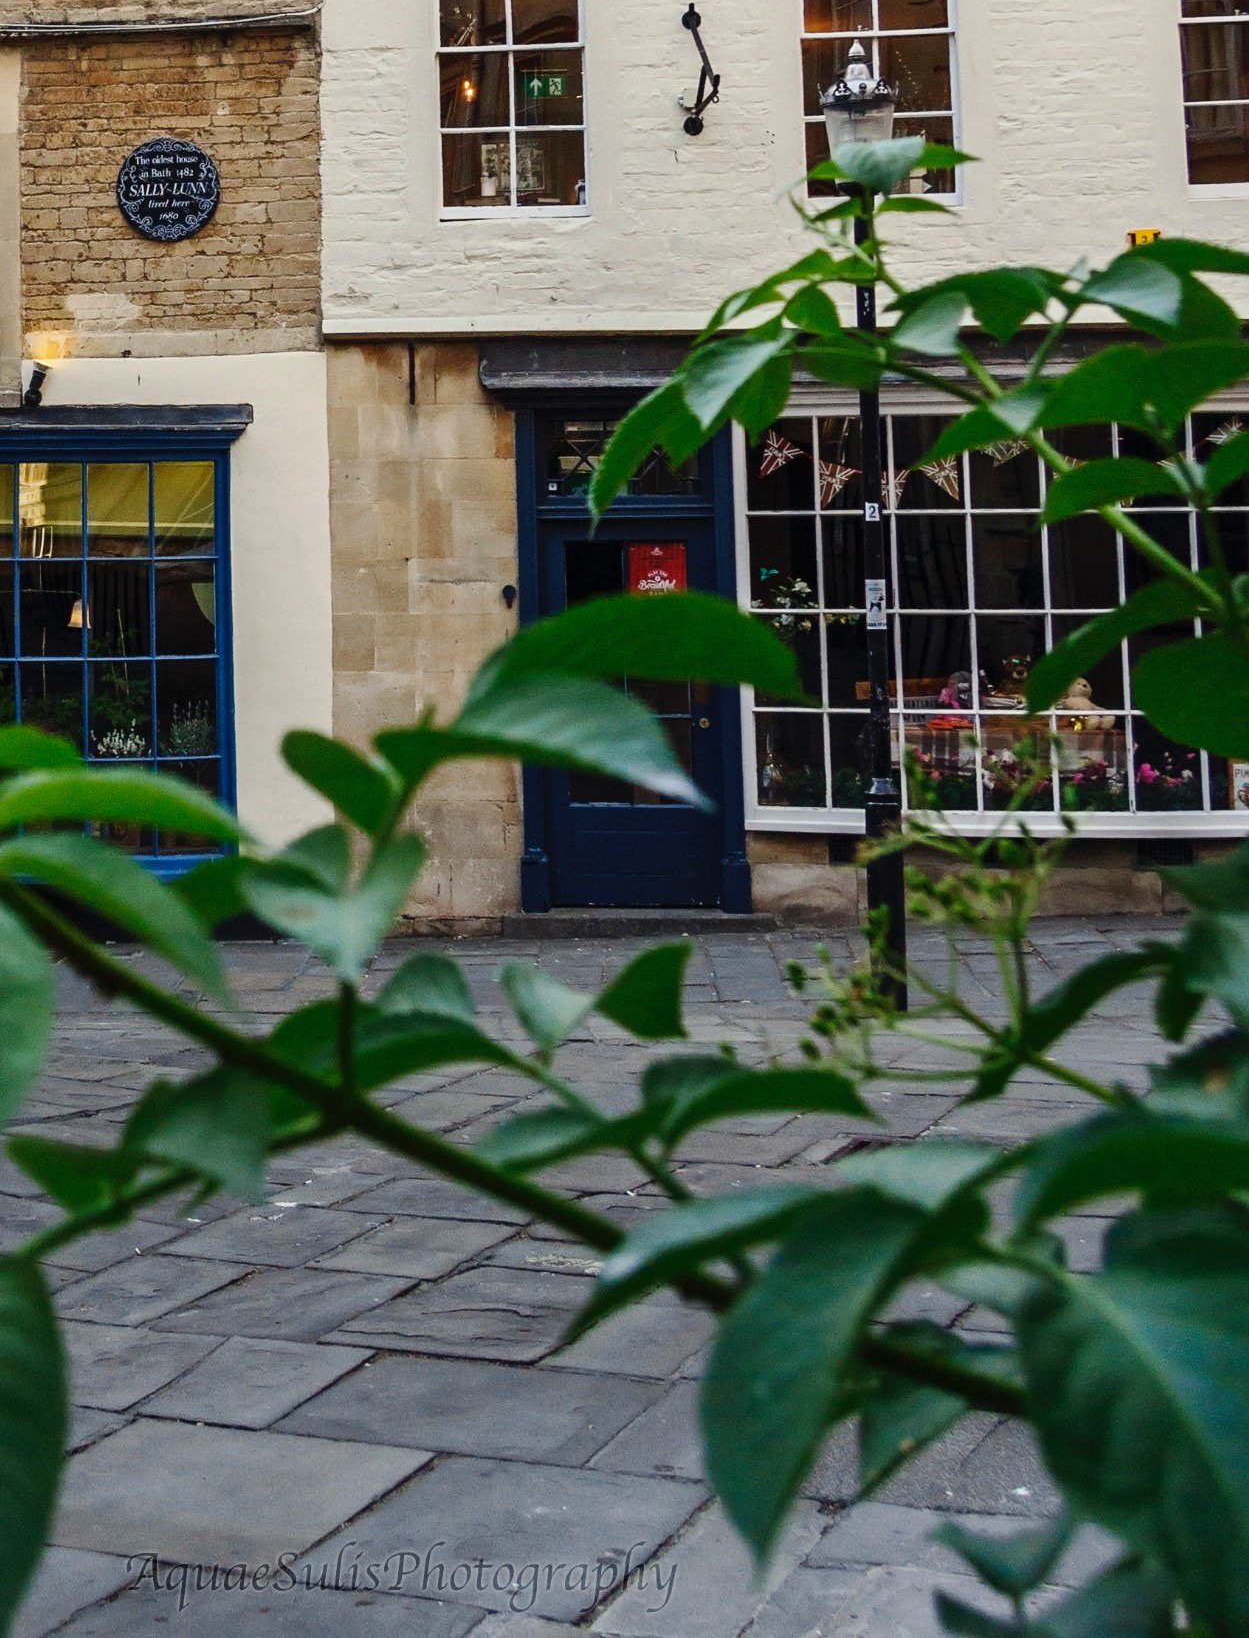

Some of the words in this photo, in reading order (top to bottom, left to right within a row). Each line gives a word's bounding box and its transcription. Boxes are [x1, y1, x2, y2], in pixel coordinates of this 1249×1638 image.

[135, 155, 150, 165] The
[152, 154, 174, 164] oldest
[176, 154, 198, 164] house
[141, 170, 149, 178] in
[151, 168, 171, 177] Bath
[176, 167, 194, 178] 1482
[129, 183, 169, 196] SALLY
[172, 182, 208, 195] LUNN
[148, 199, 170, 208] lived
[172, 199, 191, 208] here
[159, 211, 179, 220] 1680
[869, 505, 877, 518] 2
